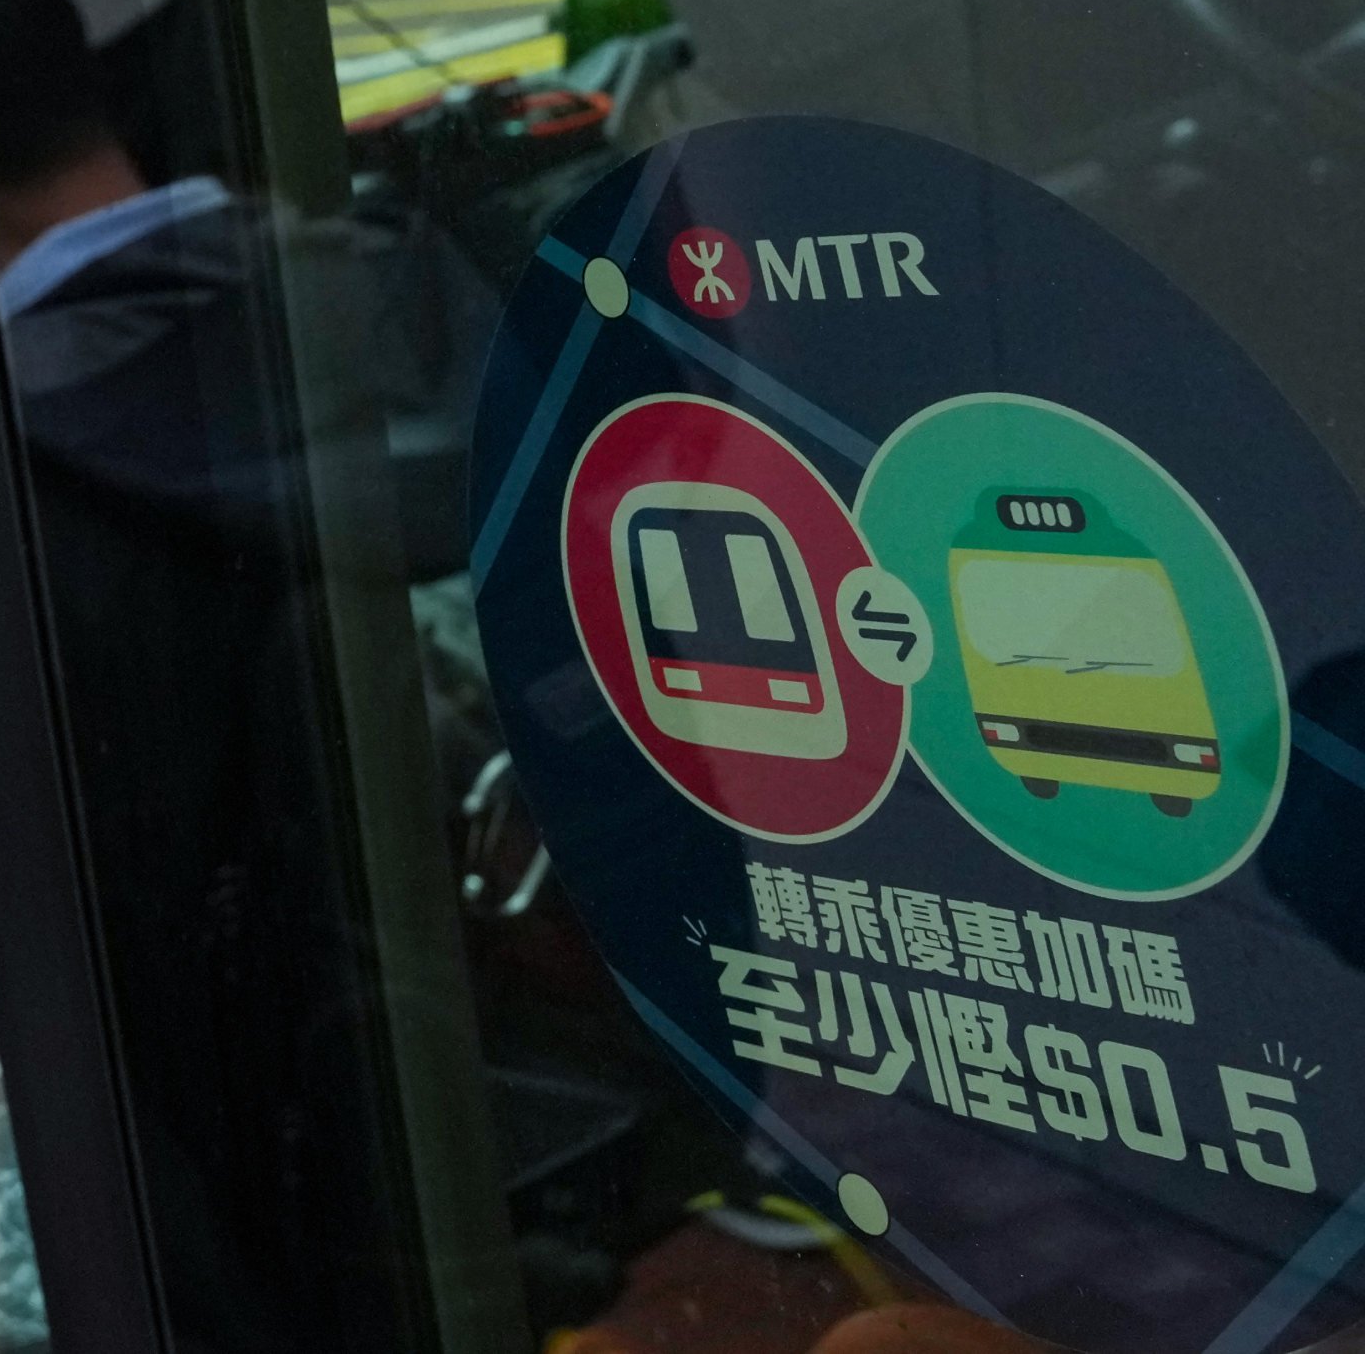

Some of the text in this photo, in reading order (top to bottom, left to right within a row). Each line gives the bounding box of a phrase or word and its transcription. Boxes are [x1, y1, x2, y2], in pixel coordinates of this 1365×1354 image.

[755, 231, 940, 303] MTR
[745, 861, 1197, 1026] 轉乘優惠加碼
